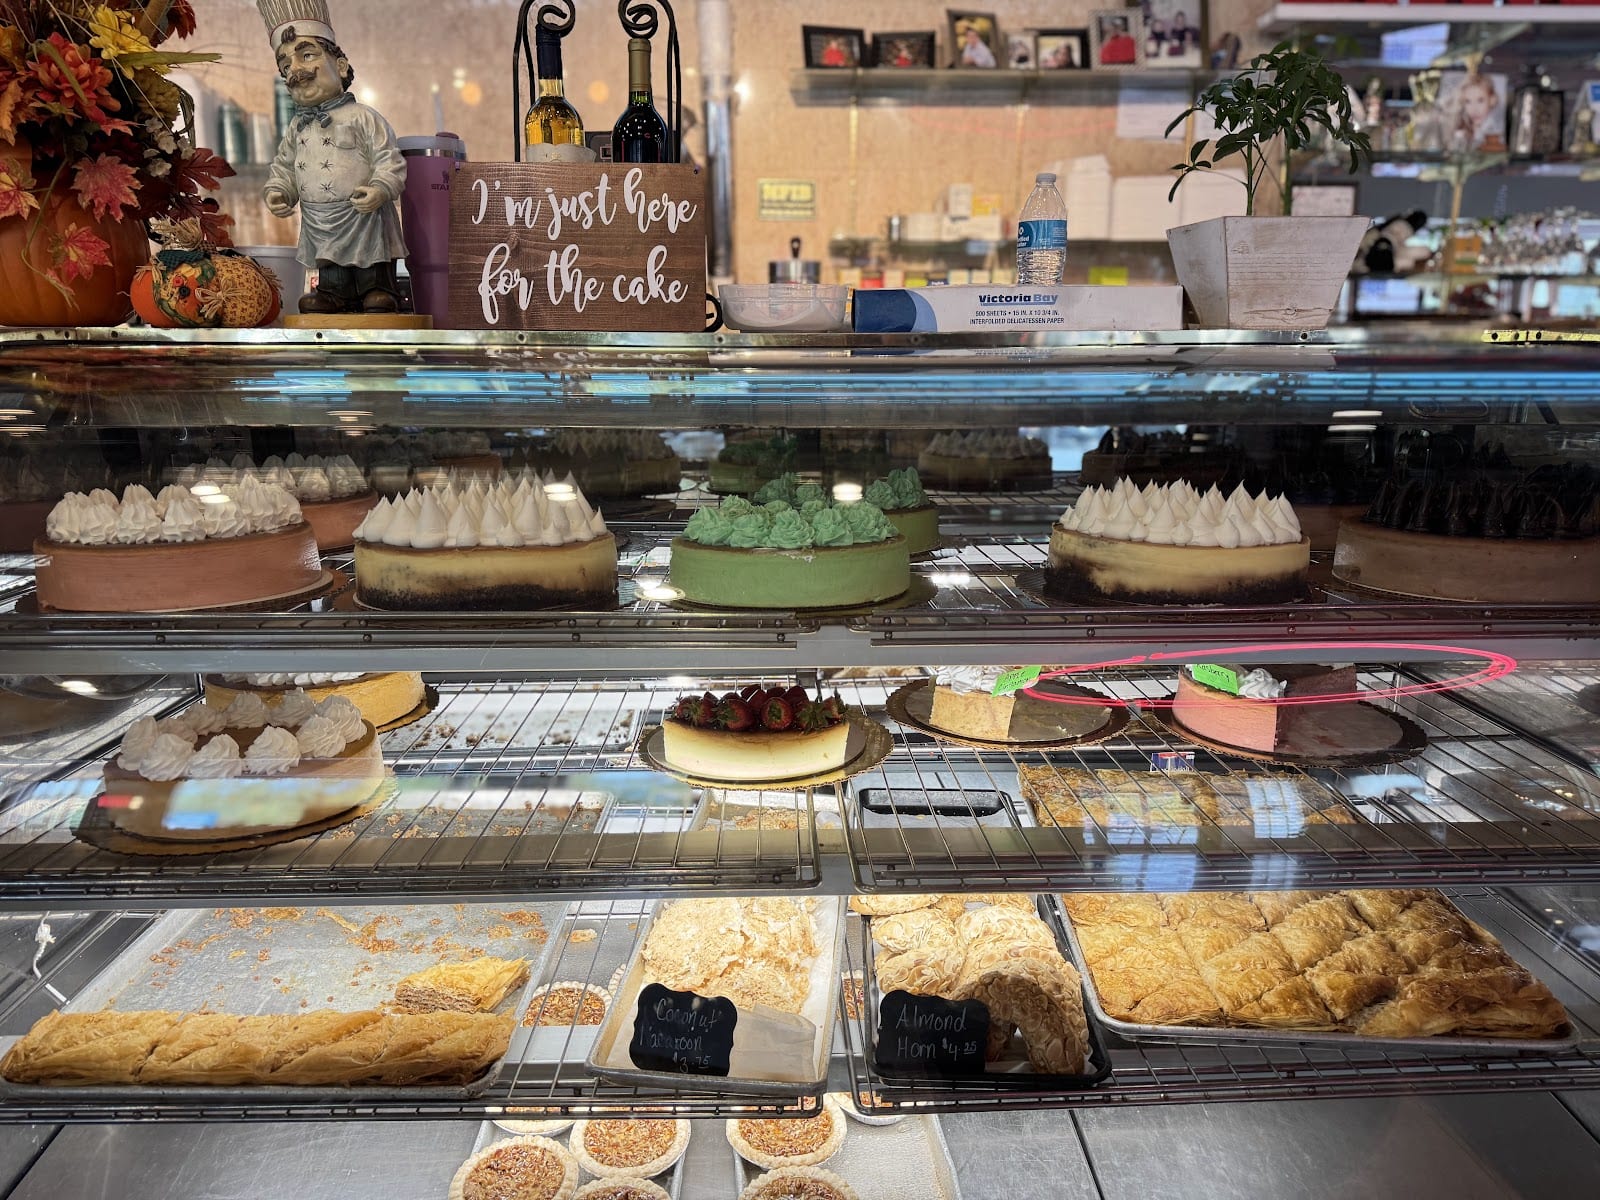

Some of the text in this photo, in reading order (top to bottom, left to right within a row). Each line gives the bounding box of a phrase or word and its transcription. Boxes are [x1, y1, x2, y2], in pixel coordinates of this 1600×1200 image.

[471, 178, 541, 229] I'm
[545, 173, 617, 241] just
[623, 168, 697, 233] here
[477, 243, 688, 325] for the cake
[978, 293, 1059, 303] Victoria Bay
[656, 998, 718, 1029] Coconut
[895, 1003, 968, 1033] Almond
[897, 1036, 937, 1060] Horn
